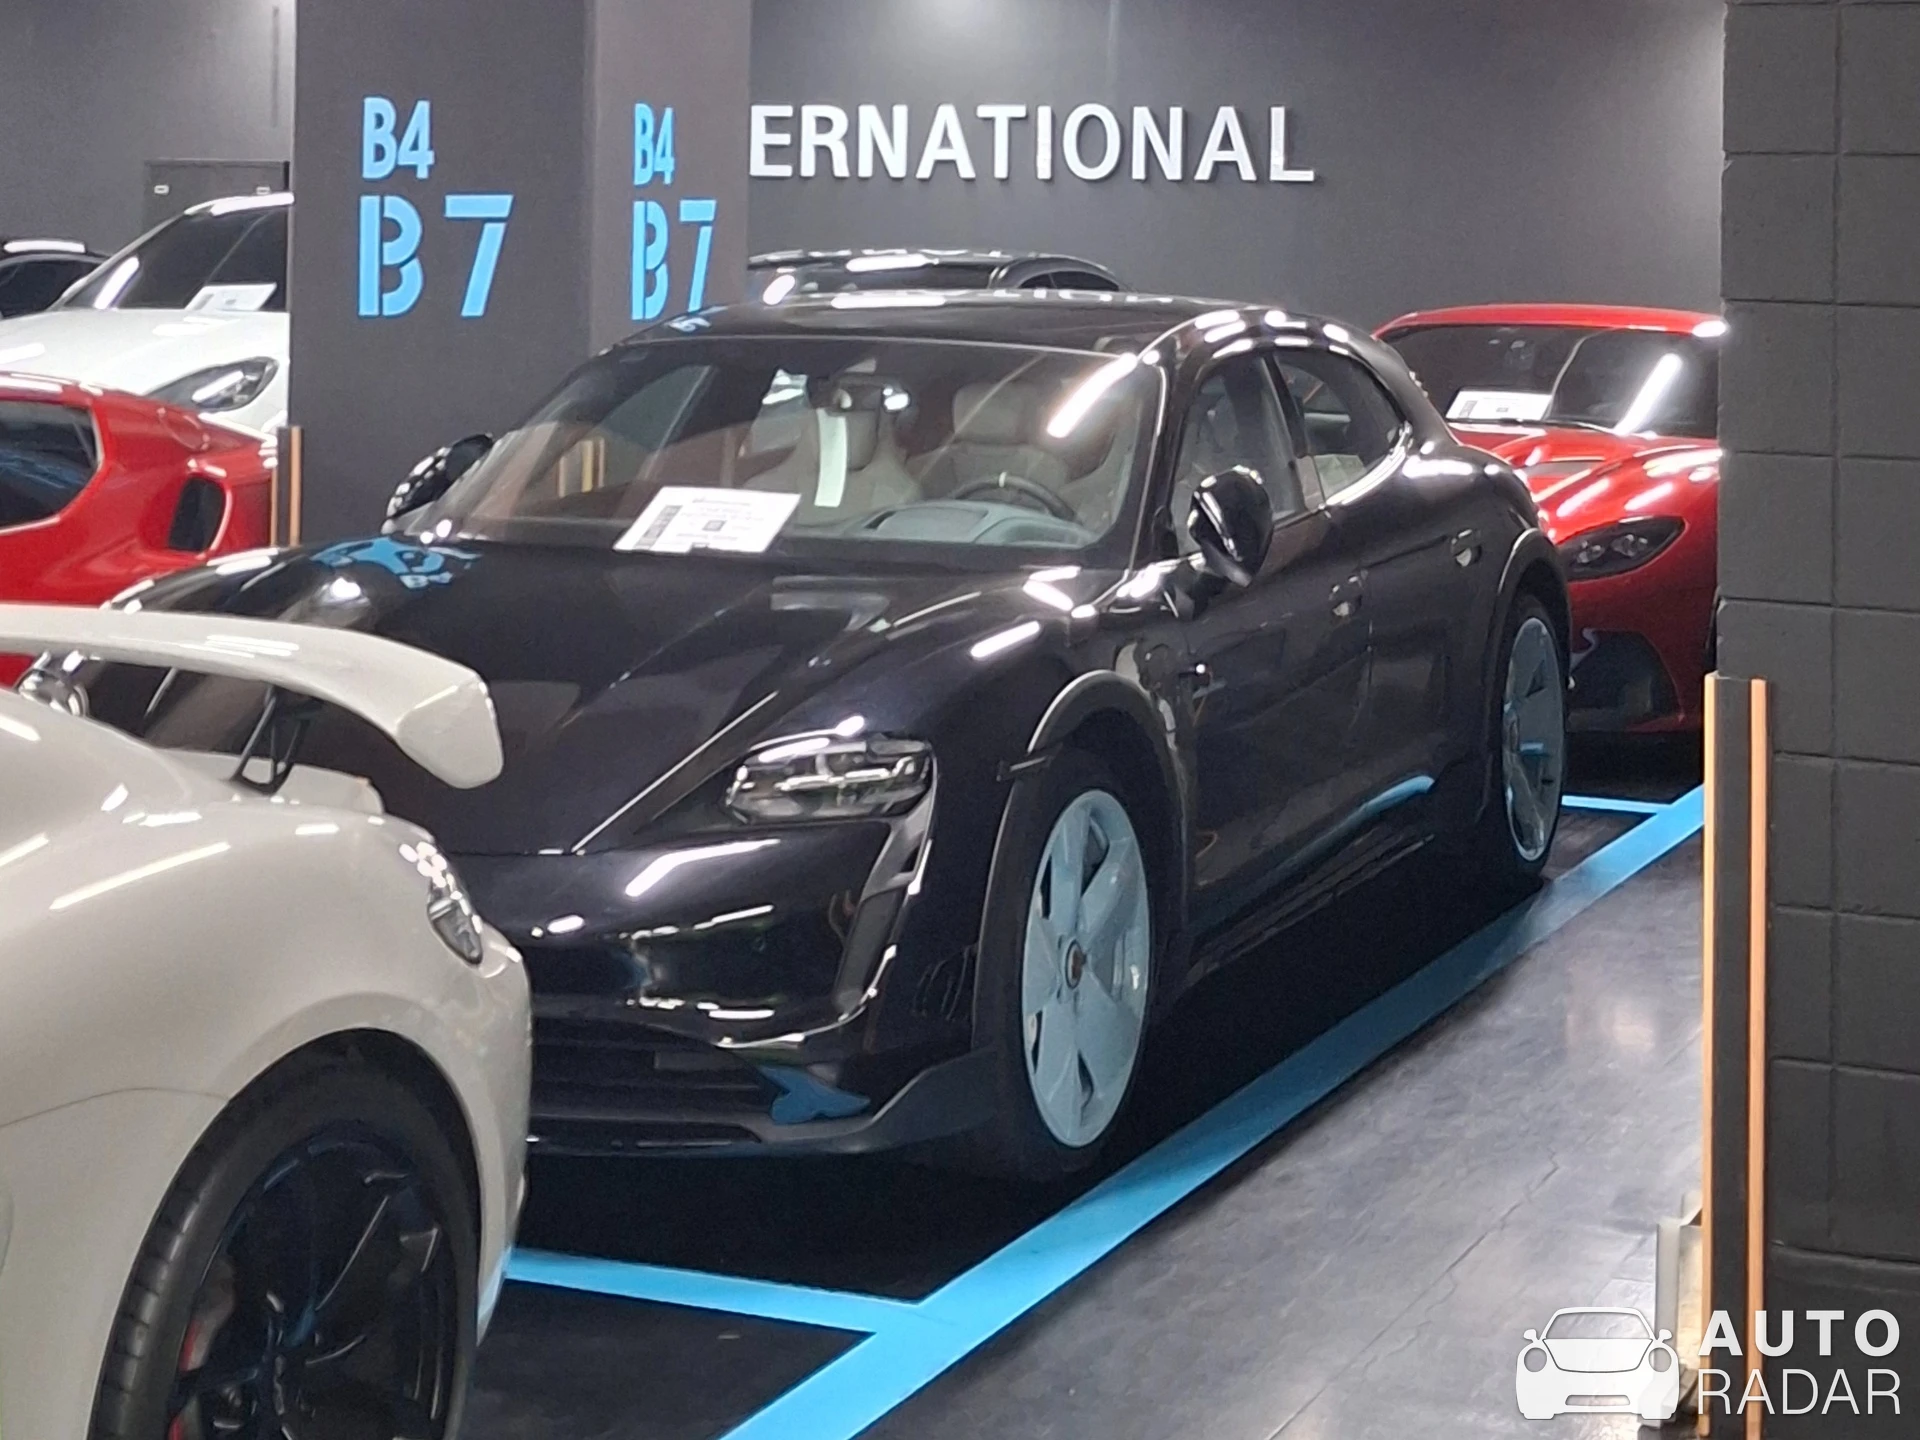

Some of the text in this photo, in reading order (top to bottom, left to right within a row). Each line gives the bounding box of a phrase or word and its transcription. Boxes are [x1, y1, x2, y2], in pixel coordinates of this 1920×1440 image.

[362, 97, 435, 179] B4
[634, 103, 675, 186] B4
[749, 103, 1315, 182] ERNATIONAL
